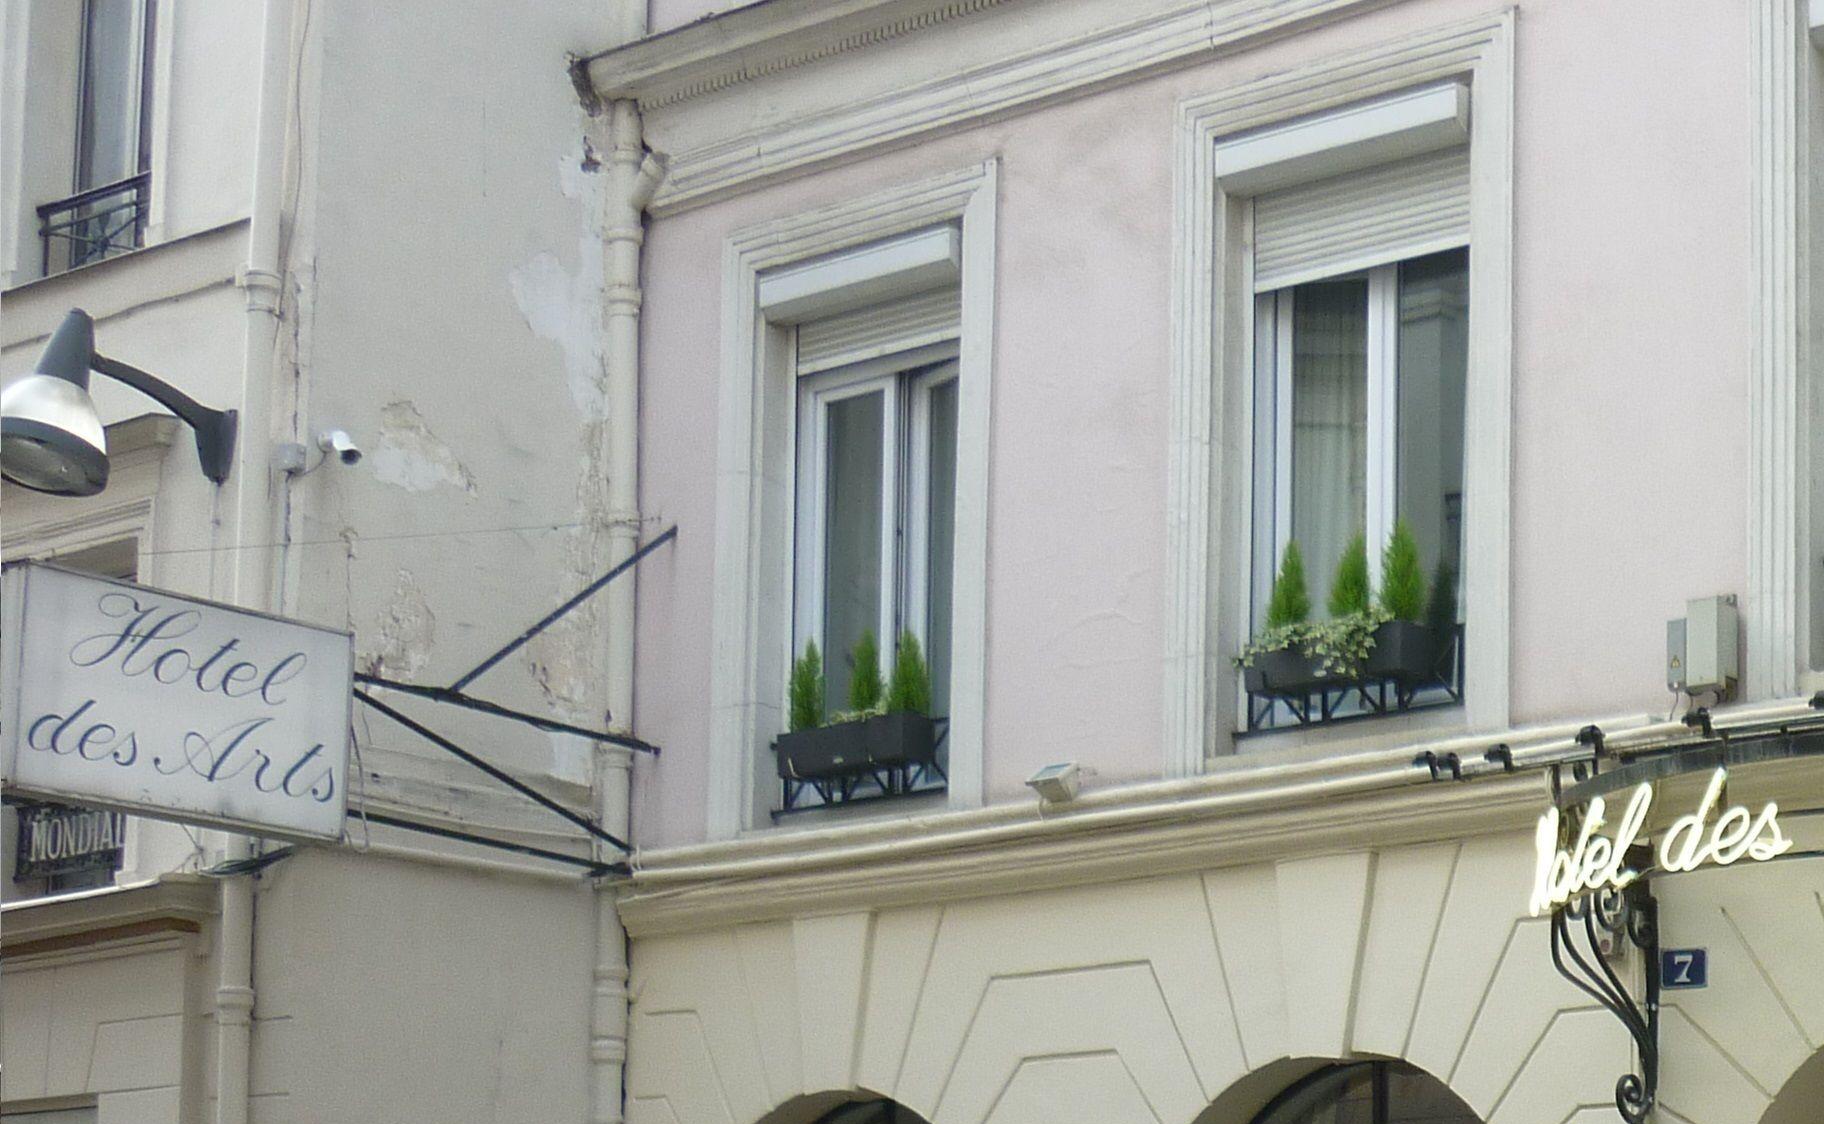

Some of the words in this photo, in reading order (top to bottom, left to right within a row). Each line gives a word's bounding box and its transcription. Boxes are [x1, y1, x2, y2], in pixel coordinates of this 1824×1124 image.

[28, 699, 137, 766] des
[154, 717, 334, 802] Arts
[1660, 767, 1793, 873] des
[1674, 955, 1693, 983] 7
